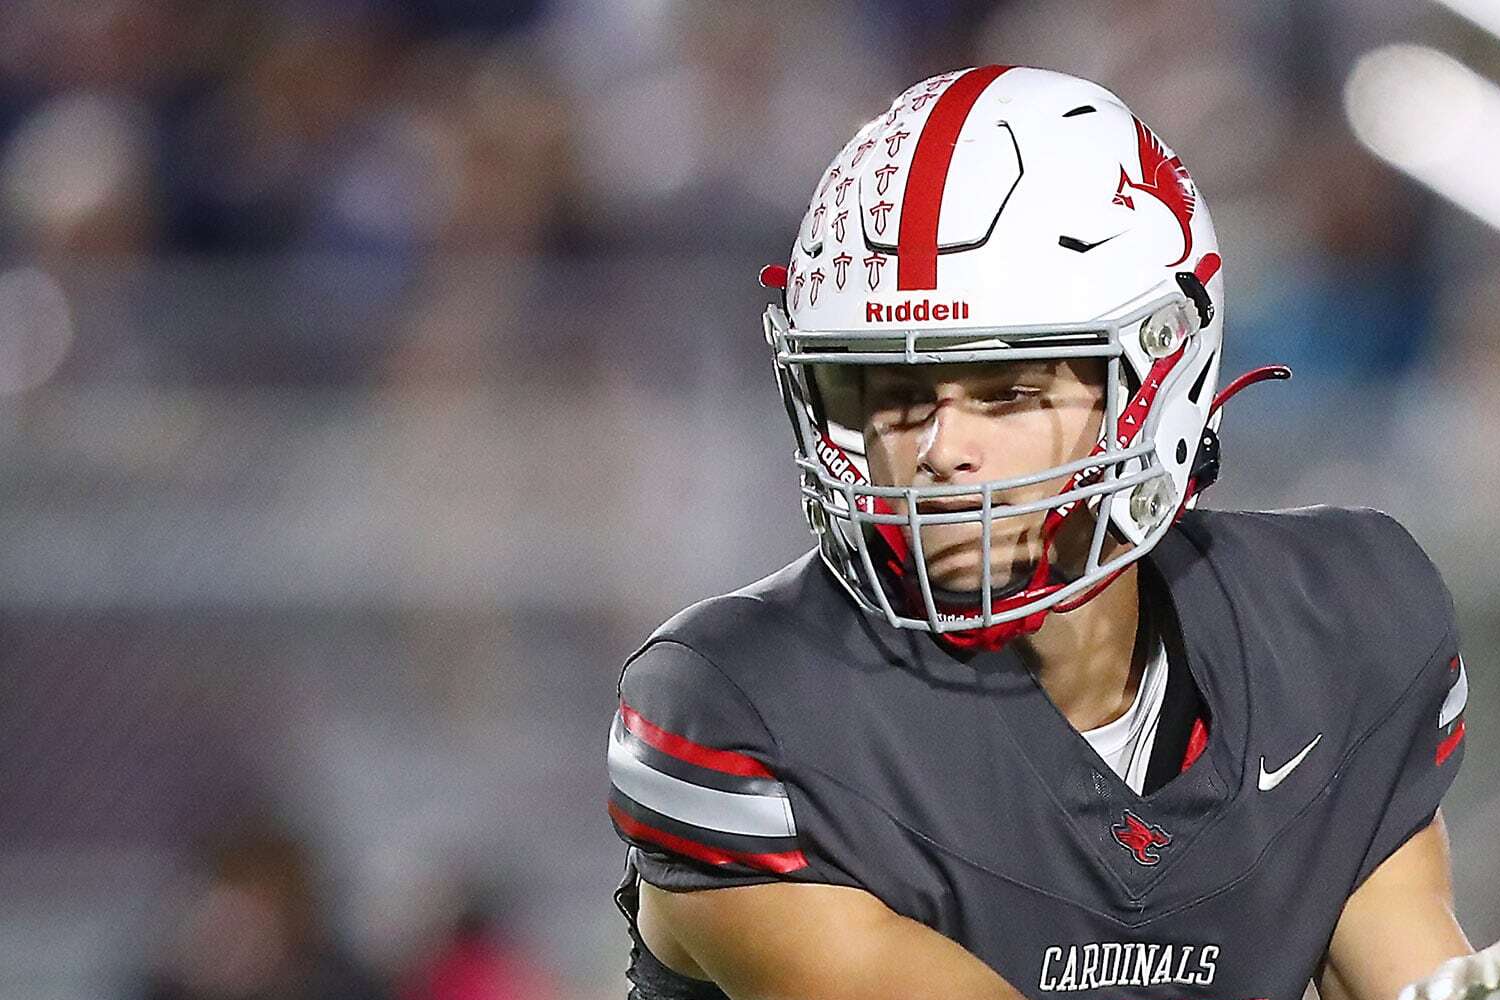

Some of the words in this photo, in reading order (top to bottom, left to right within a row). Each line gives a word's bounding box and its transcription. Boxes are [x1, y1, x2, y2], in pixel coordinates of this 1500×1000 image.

[865, 299, 969, 322] Riddell
[811, 426, 872, 493] Ridde
[1039, 943, 1220, 991] CARDINALS
